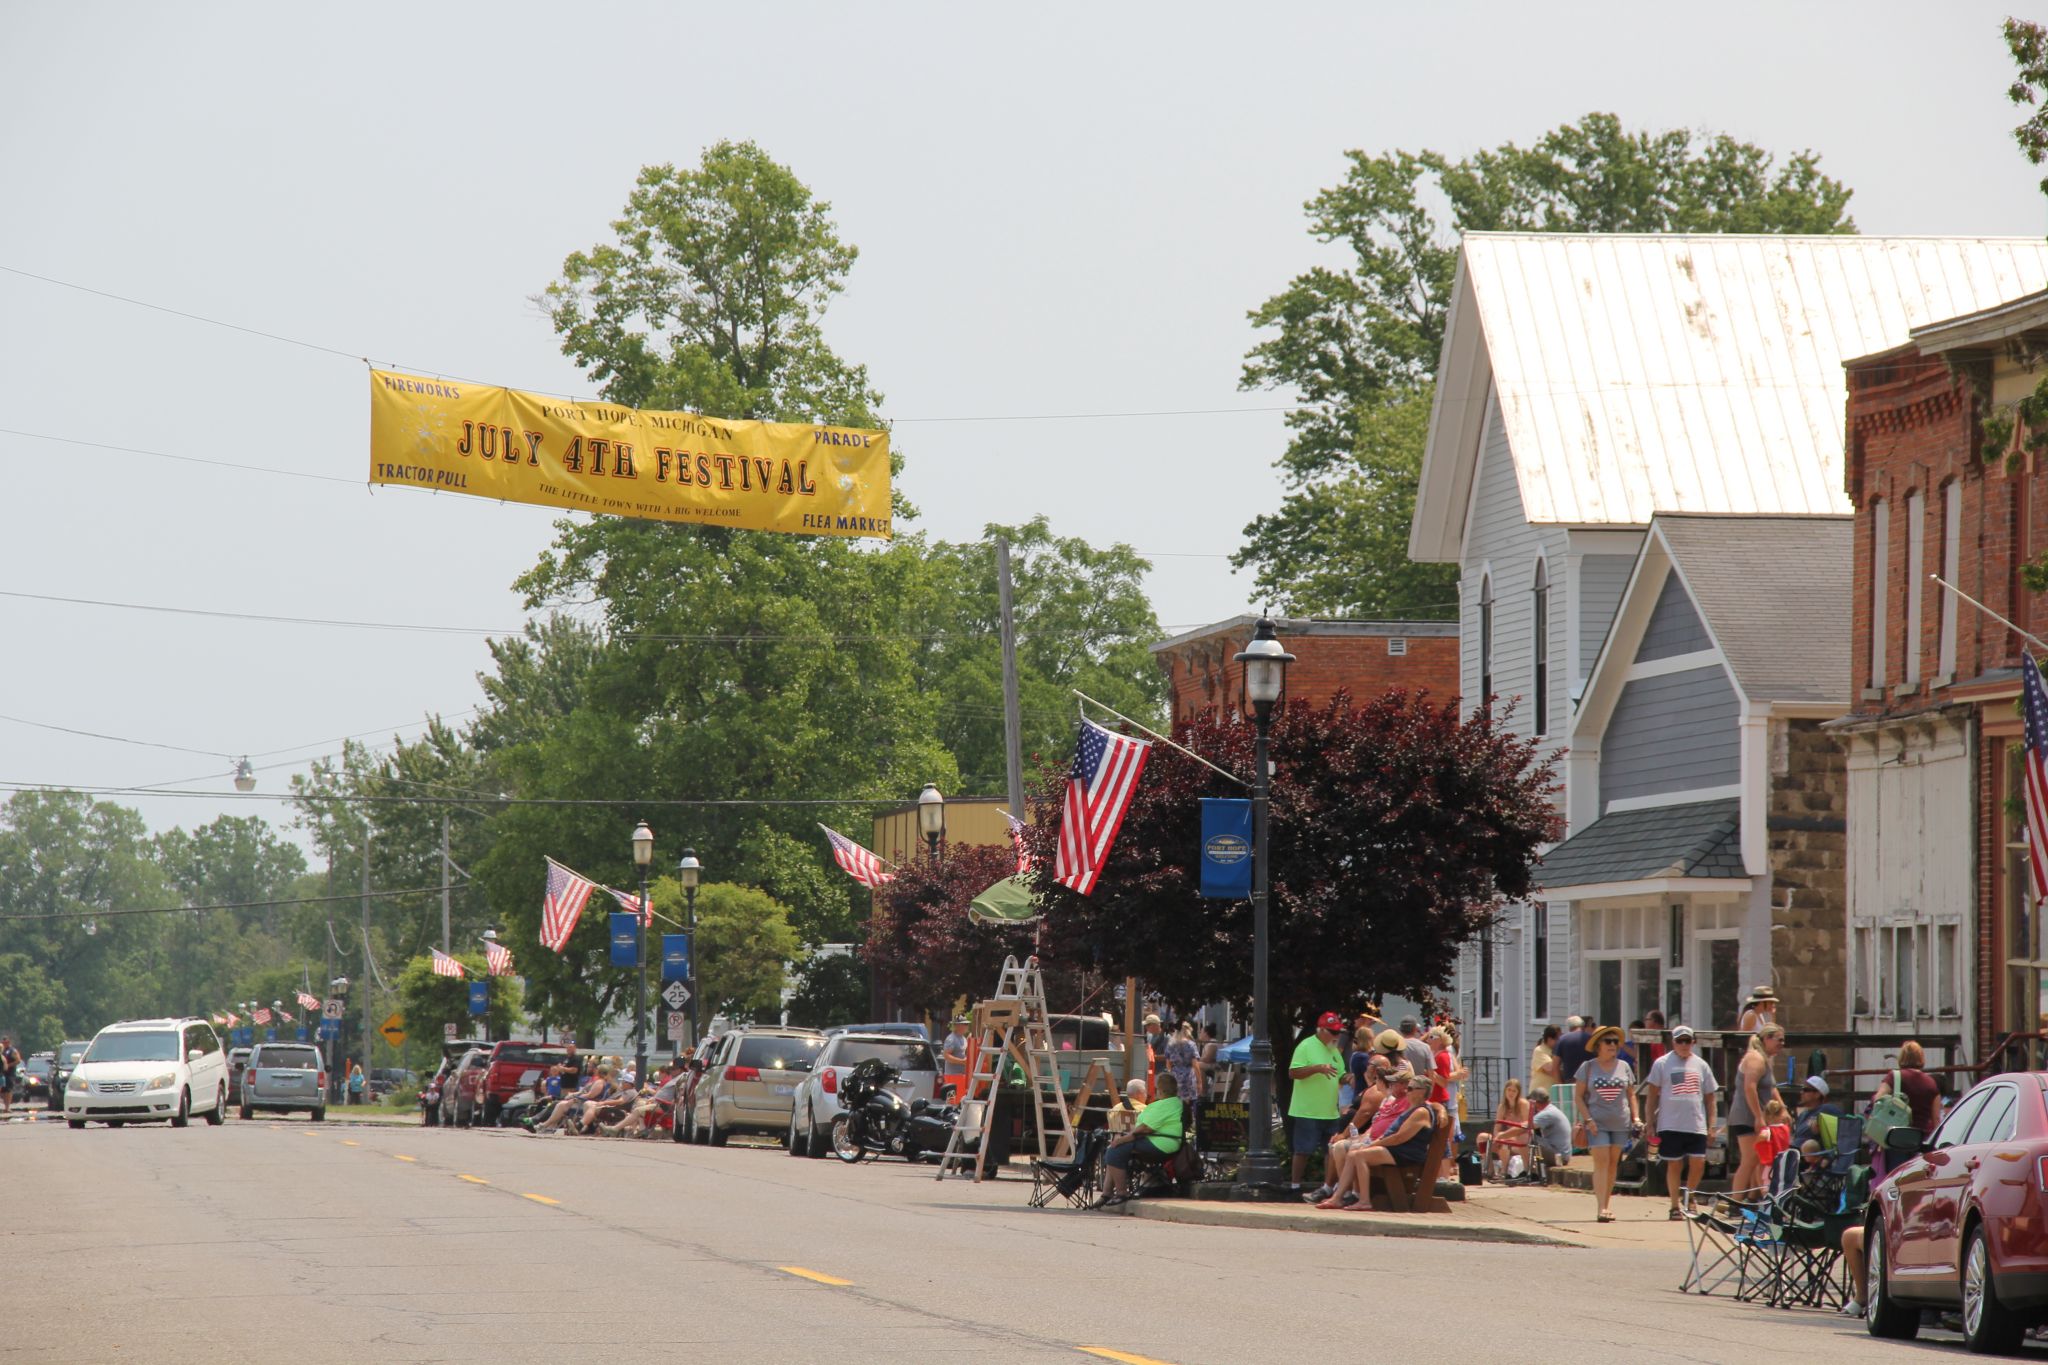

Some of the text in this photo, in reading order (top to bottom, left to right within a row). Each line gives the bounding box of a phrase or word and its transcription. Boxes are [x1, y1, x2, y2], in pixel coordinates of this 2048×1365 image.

[385, 376, 460, 399] FIREWORKS
[542, 405, 587, 421] PORT
[651, 416, 733, 441] MICHIGAN
[814, 431, 871, 448] PARADE
[457, 419, 816, 496] JULY 4TH FESTIVAL
[377, 463, 467, 488] TRACTOR PULL
[538, 482, 741, 518] THE LITTLE TOWN WITH A BIG WELCOME
[802, 513, 889, 533] FLEA MARKET
[669, 991, 686, 1002] 25
